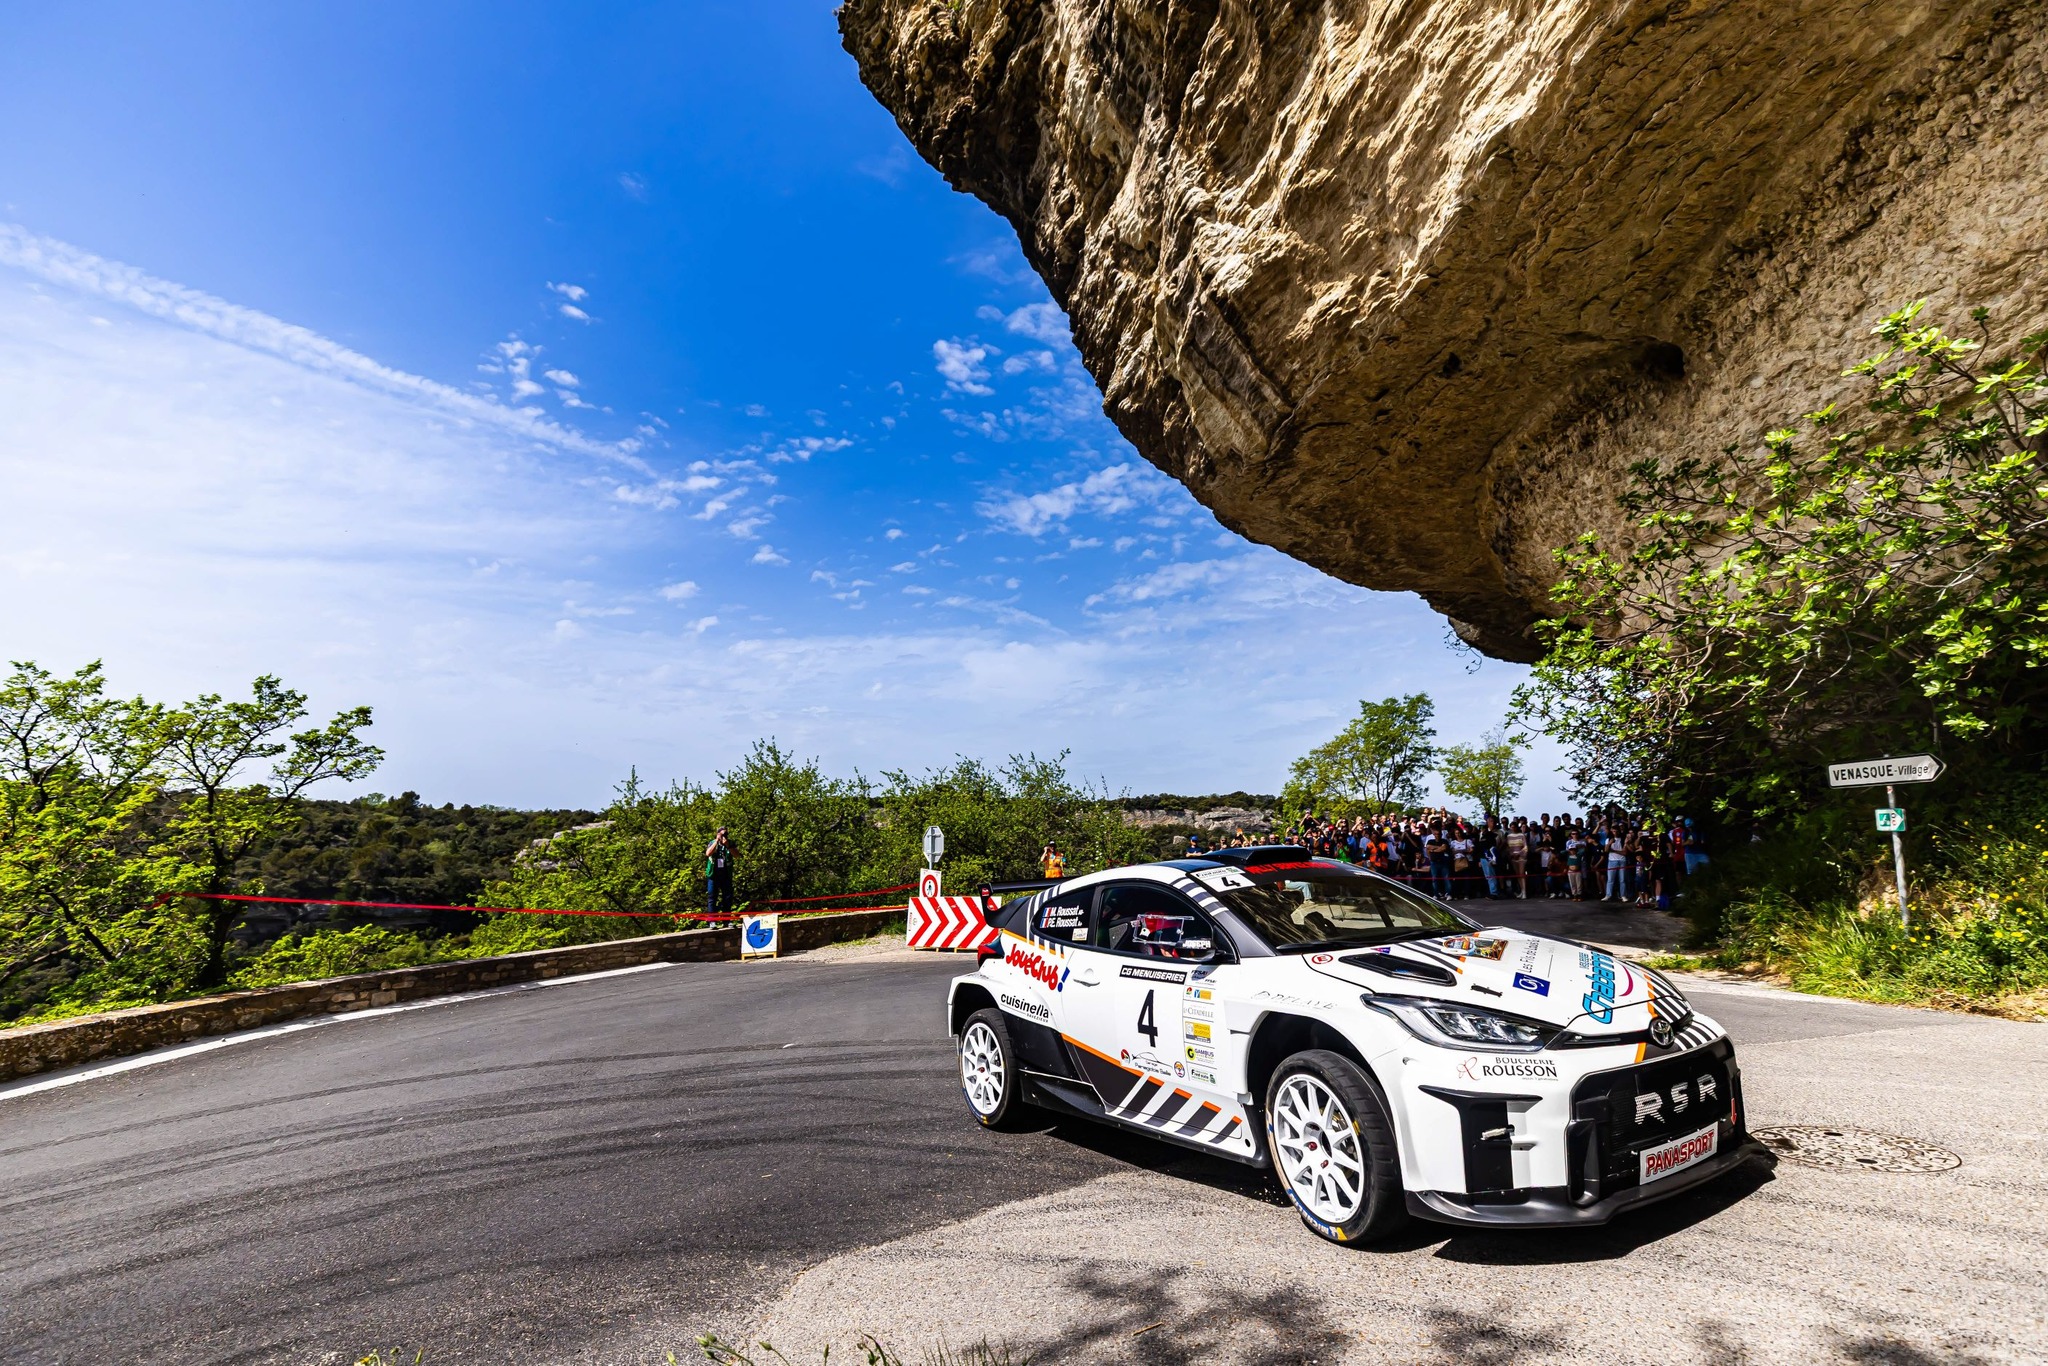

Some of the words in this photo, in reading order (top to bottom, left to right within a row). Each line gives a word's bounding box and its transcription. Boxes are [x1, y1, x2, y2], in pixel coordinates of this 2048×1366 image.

[1221, 877, 1241, 887] 4
[1057, 905, 1079, 916] Roussat
[1056, 916, 1079, 927] Roussat
[1121, 967, 1132, 976] CG
[1132, 968, 1185, 982] MENUISERIES
[1001, 993, 1049, 1018] cuisinella
[1137, 989, 1158, 1048] 4
[1495, 1056, 1555, 1065] BOUCHERIE
[1482, 1065, 1558, 1077] ROUSSON
[1645, 1129, 1715, 1177] PANASPORT
